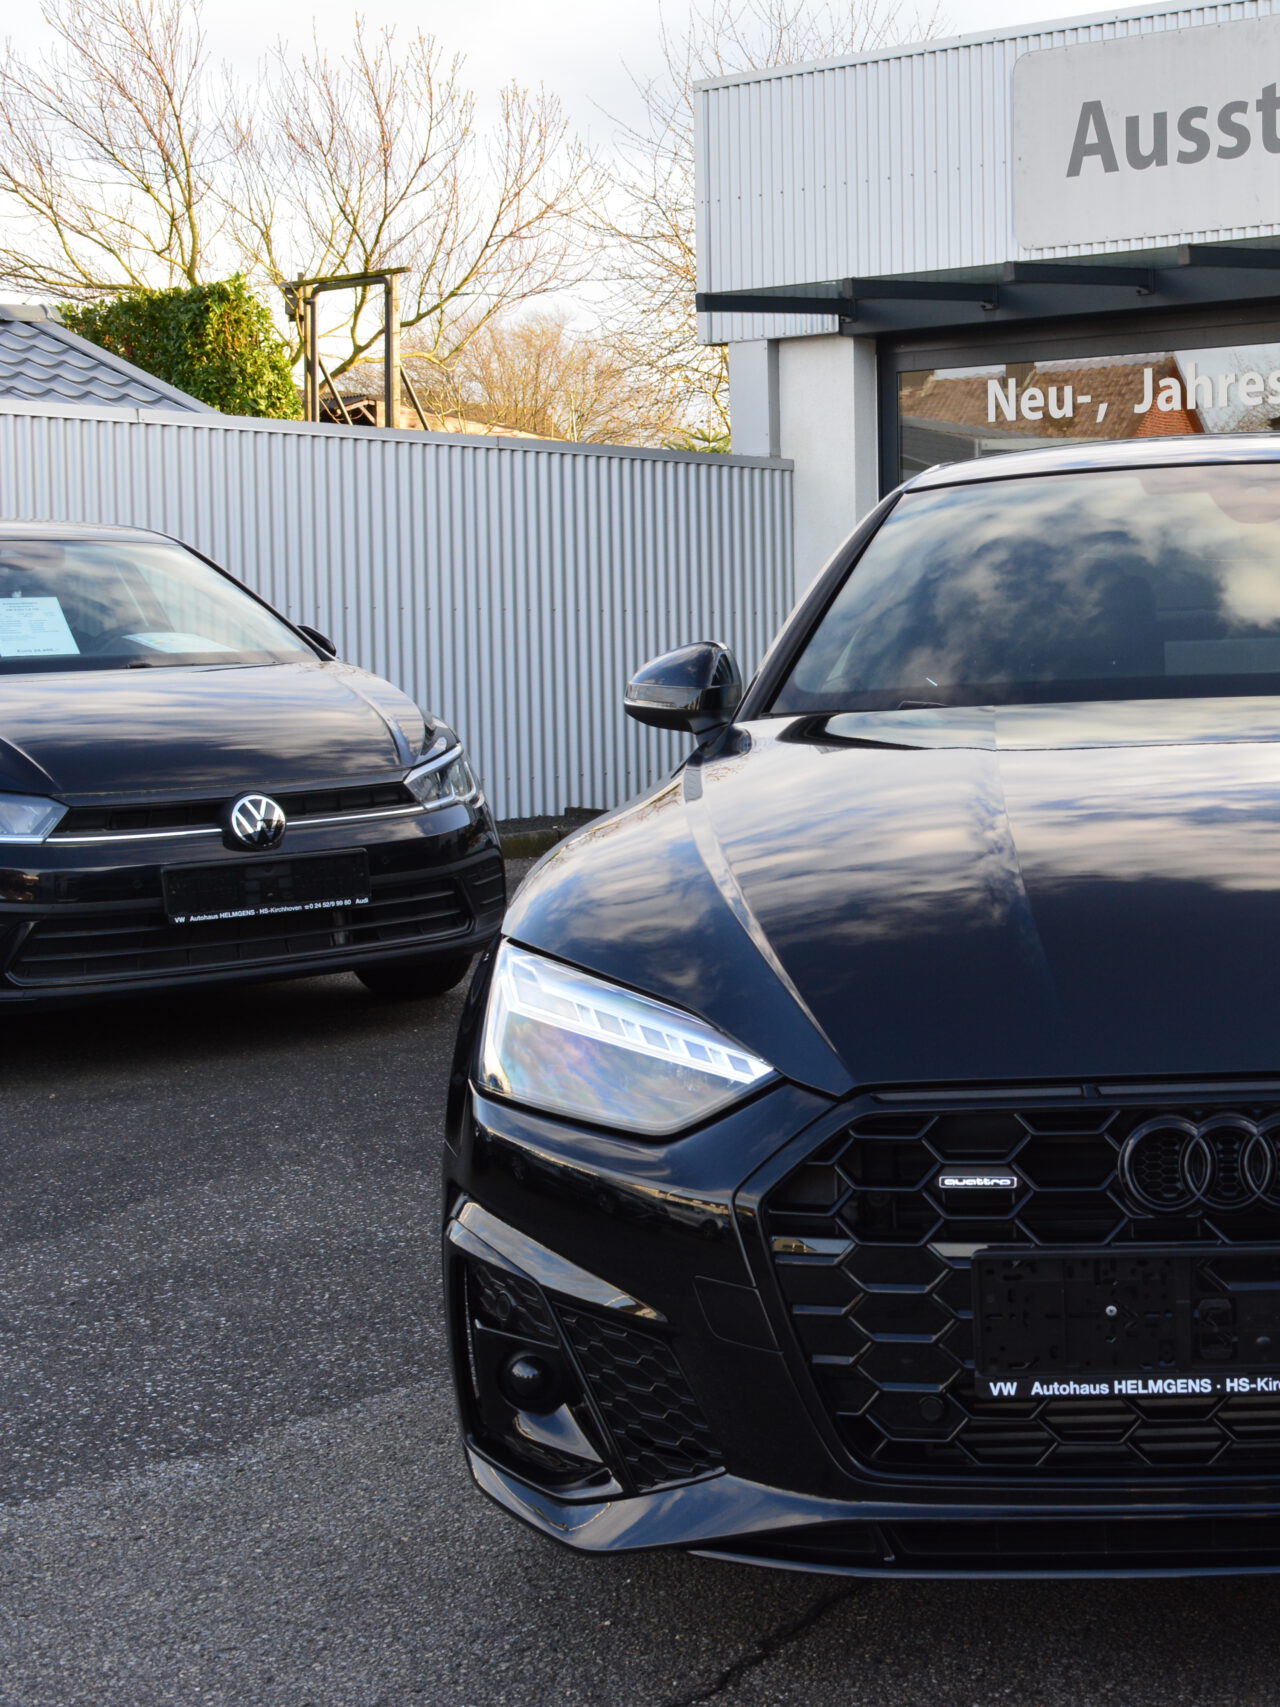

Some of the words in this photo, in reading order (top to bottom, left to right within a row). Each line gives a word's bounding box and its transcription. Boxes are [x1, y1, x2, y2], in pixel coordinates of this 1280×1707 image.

[986, 377, 1109, 424] Neu-,
[174, 915, 186, 924] VW
[189, 912, 219, 922] Autohaus
[219, 908, 256, 919] HELMGENS
[259, 904, 303, 915] HS-Kirchhoven
[943, 1177, 1012, 1187] quattro
[989, 1381, 1018, 1396] VW
[1031, 1381, 1110, 1396] Autohaus
[1113, 1378, 1212, 1395] HELMGENS
